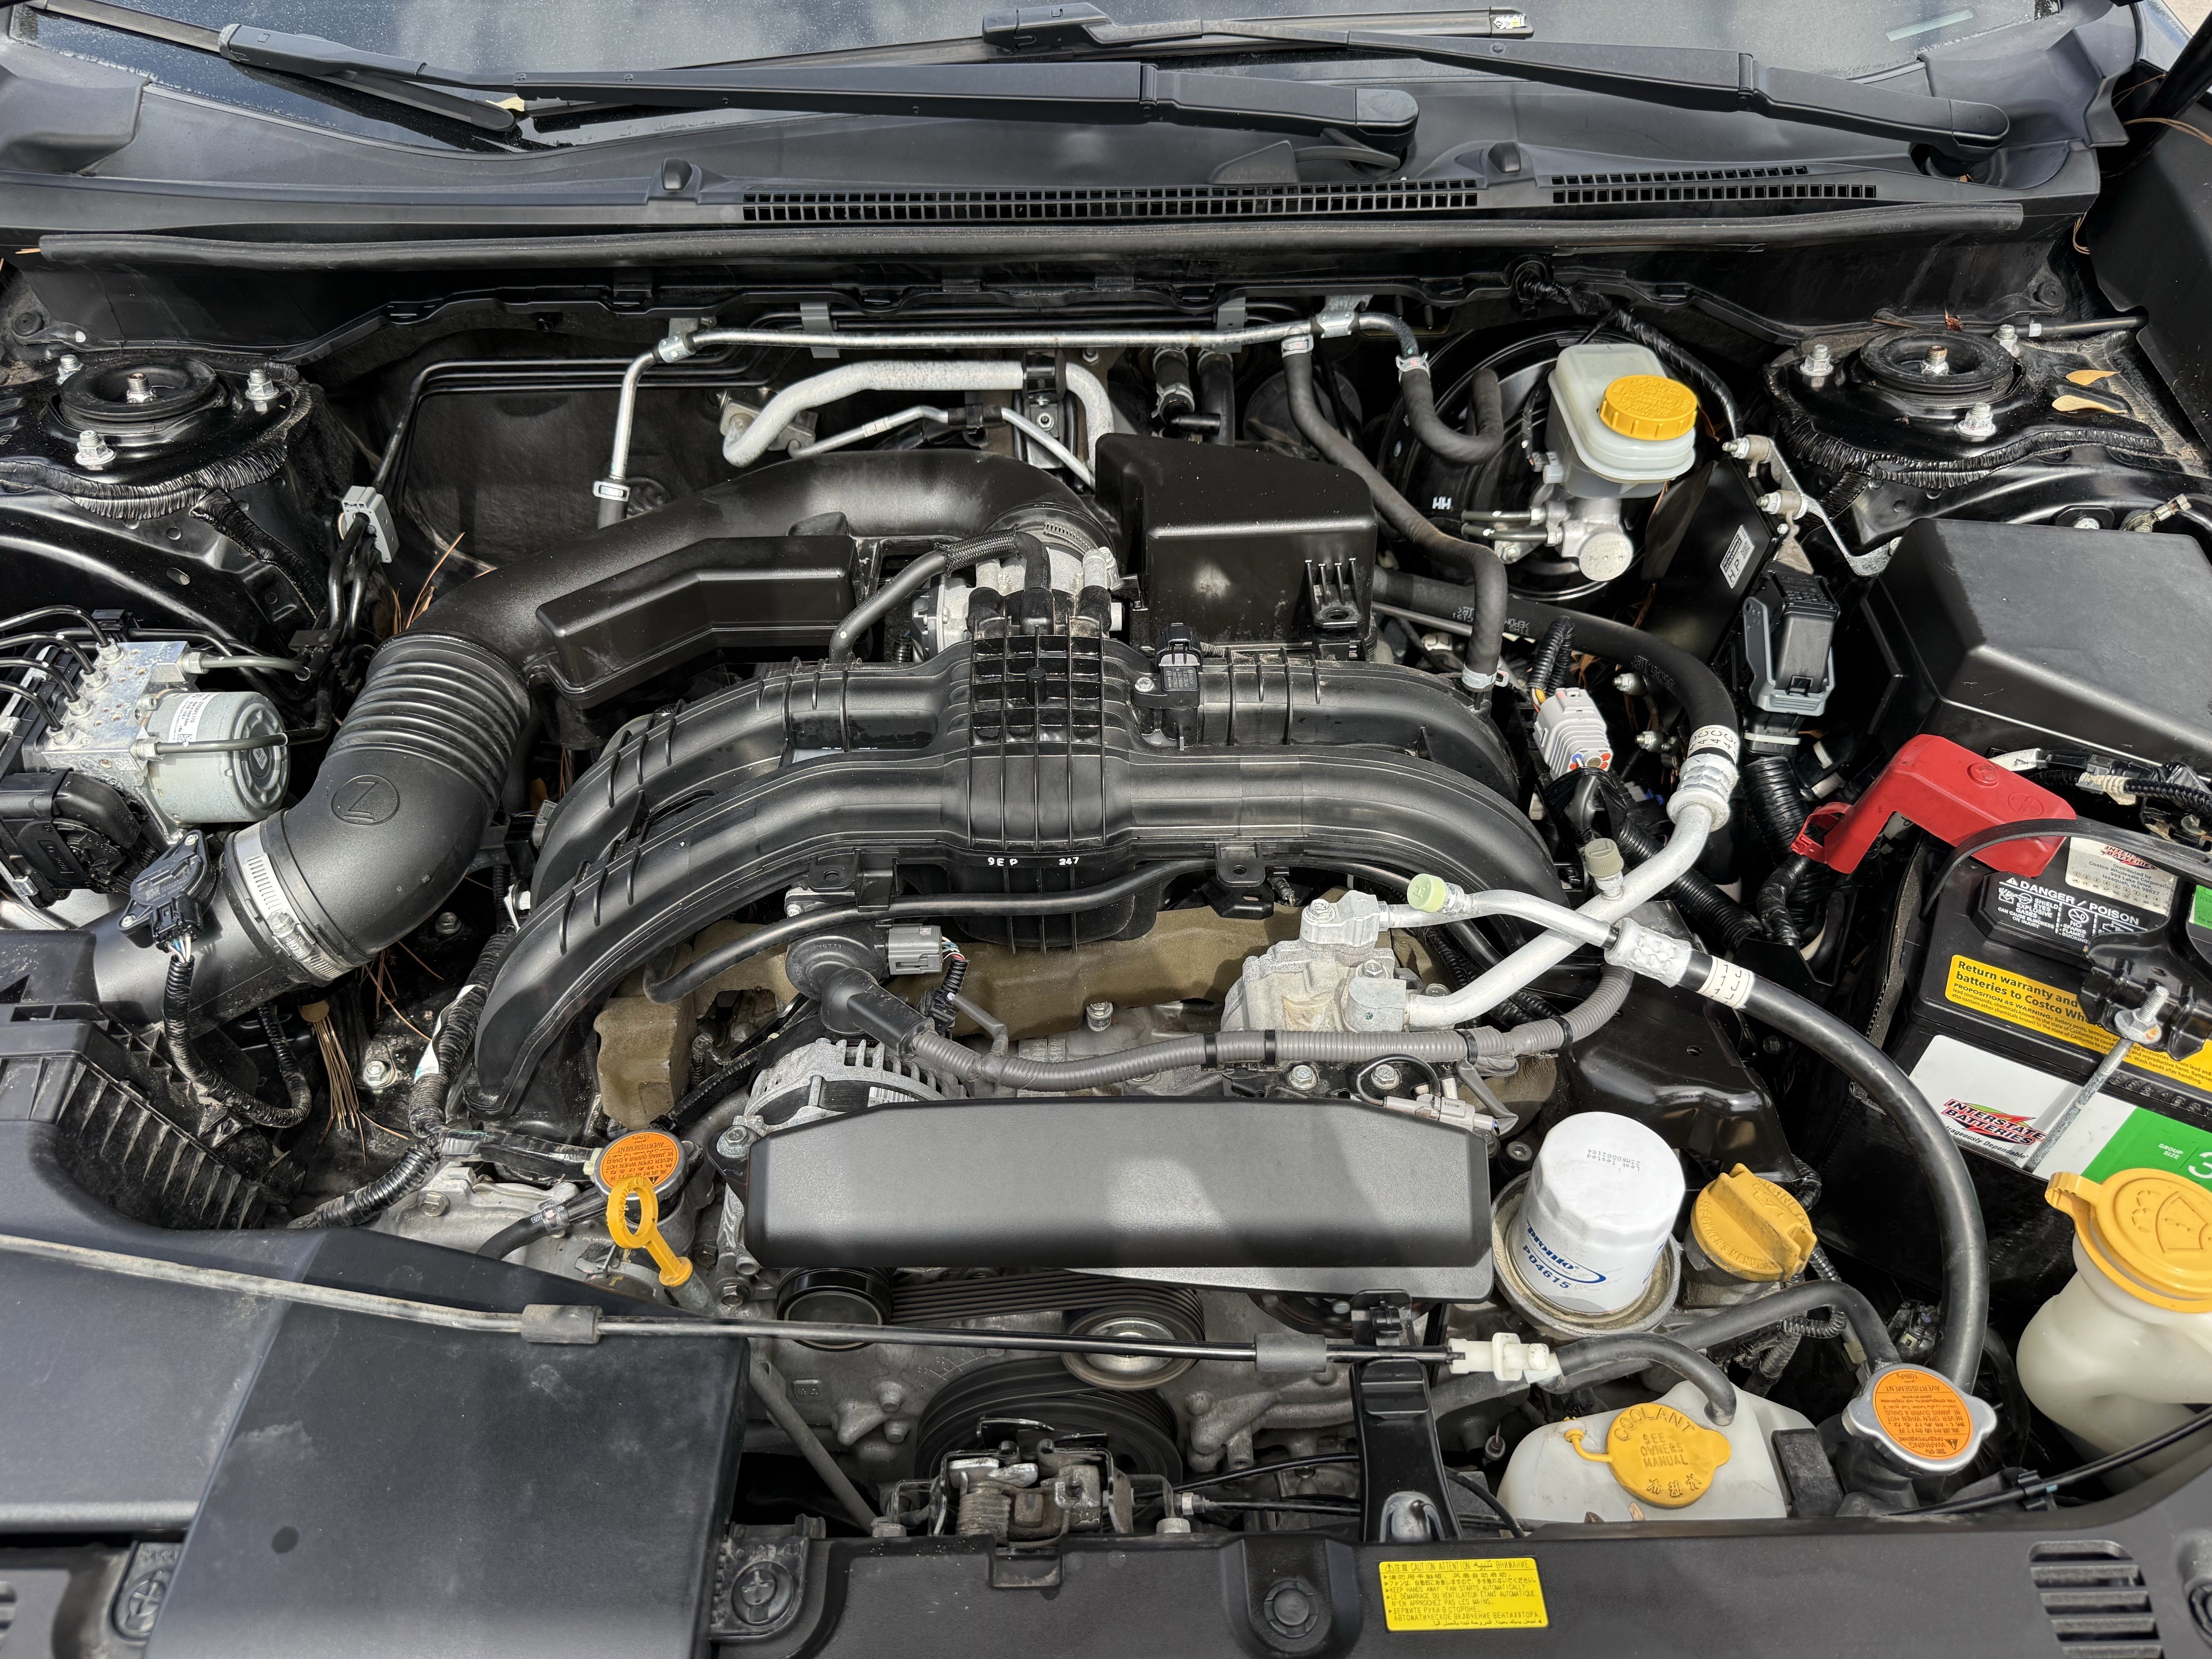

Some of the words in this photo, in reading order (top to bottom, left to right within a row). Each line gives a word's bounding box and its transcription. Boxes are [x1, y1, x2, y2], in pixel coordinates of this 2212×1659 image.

[2107, 850, 2155, 870] BATTERIES
[2089, 861, 2108, 871] Costco
[2110, 868, 2139, 881] Wholesale
[2113, 864, 2143, 876] Distributed
[2142, 887, 2159, 896] 98027
[2020, 881, 2075, 905] DANGER
[2089, 903, 2139, 925] POISON
[2033, 902, 2051, 912] EYES
[2034, 898, 2058, 910] SHIELD
[2015, 907, 2038, 919] GASES
[2016, 902, 2052, 918] EXPLOSIVE
[2009, 911, 2025, 919] CAUSE
[2026, 916, 2054, 929] BLINDNESS
[2020, 919, 2039, 929] INJURY
[2069, 920, 2082, 928] NO
[2062, 927, 2085, 939] FLAMES
[2063, 923, 2086, 934] SPARKS
[2061, 932, 2088, 944] SMOKING
[1958, 960, 1997, 980] Return
[1999, 974, 2053, 1001] warranty
[2055, 993, 2079, 1008] and
[1956, 970, 2008, 996] batteries
[2009, 989, 2022, 1000] to
[2025, 994, 2063, 1015] Costco
[1954, 982, 2002, 1003] PROPOSITION
[2015, 1003, 2053, 1020] WARNING:
[2055, 1017, 2072, 1027] Battery
[2073, 1024, 2087, 1032] posts,
[2088, 1029, 2110, 1040] terminals
[2141, 1047, 2168, 1061] accessories
[1964, 991, 1993, 1006] compounds,
[2070, 1027, 2094, 1040] California
[2100, 1039, 2114, 1047] cause
[2142, 1053, 2173, 1068] reproductive
[2175, 1065, 2189, 1073] harm.
[1962, 996, 1980, 1006] contain
[1980, 1002, 1994, 1011] other
[1994, 1007, 2018, 1019] chemicals
[2019, 1016, 2035, 1025] known
[2051, 1027, 2063, 1035] state
[2070, 1033, 2094, 1046] California
[2134, 1056, 2147, 1064] Wash
[2148, 1061, 2164, 1070] hands
[2165, 1067, 2177, 1075] after
[2178, 1071, 2202, 1084] handling.
[1945, 1109, 2033, 1144] BATTERIES
[1948, 1101, 2046, 1140] INTERSTATE
[618, 1142, 663, 1152] AVERTISSEMENT
[2158, 1143, 2184, 1154] GROUP
[1587, 1154, 1616, 1166] Tested
[2163, 1151, 2180, 1159] SIZE
[1622, 1163, 1640, 1171] Leak
[1614, 1407, 1695, 1441] COOLANT
[1643, 1432, 1666, 1444] SEE
[1640, 1442, 1684, 1456] OWNERS
[1643, 1454, 1688, 1468] MANUAL
[1410, 1562, 1435, 1571] CAUTION
[1438, 1561, 1470, 1570] ATTENTION
[1495, 1560, 1528, 1568] ВНИМАНИЕ
